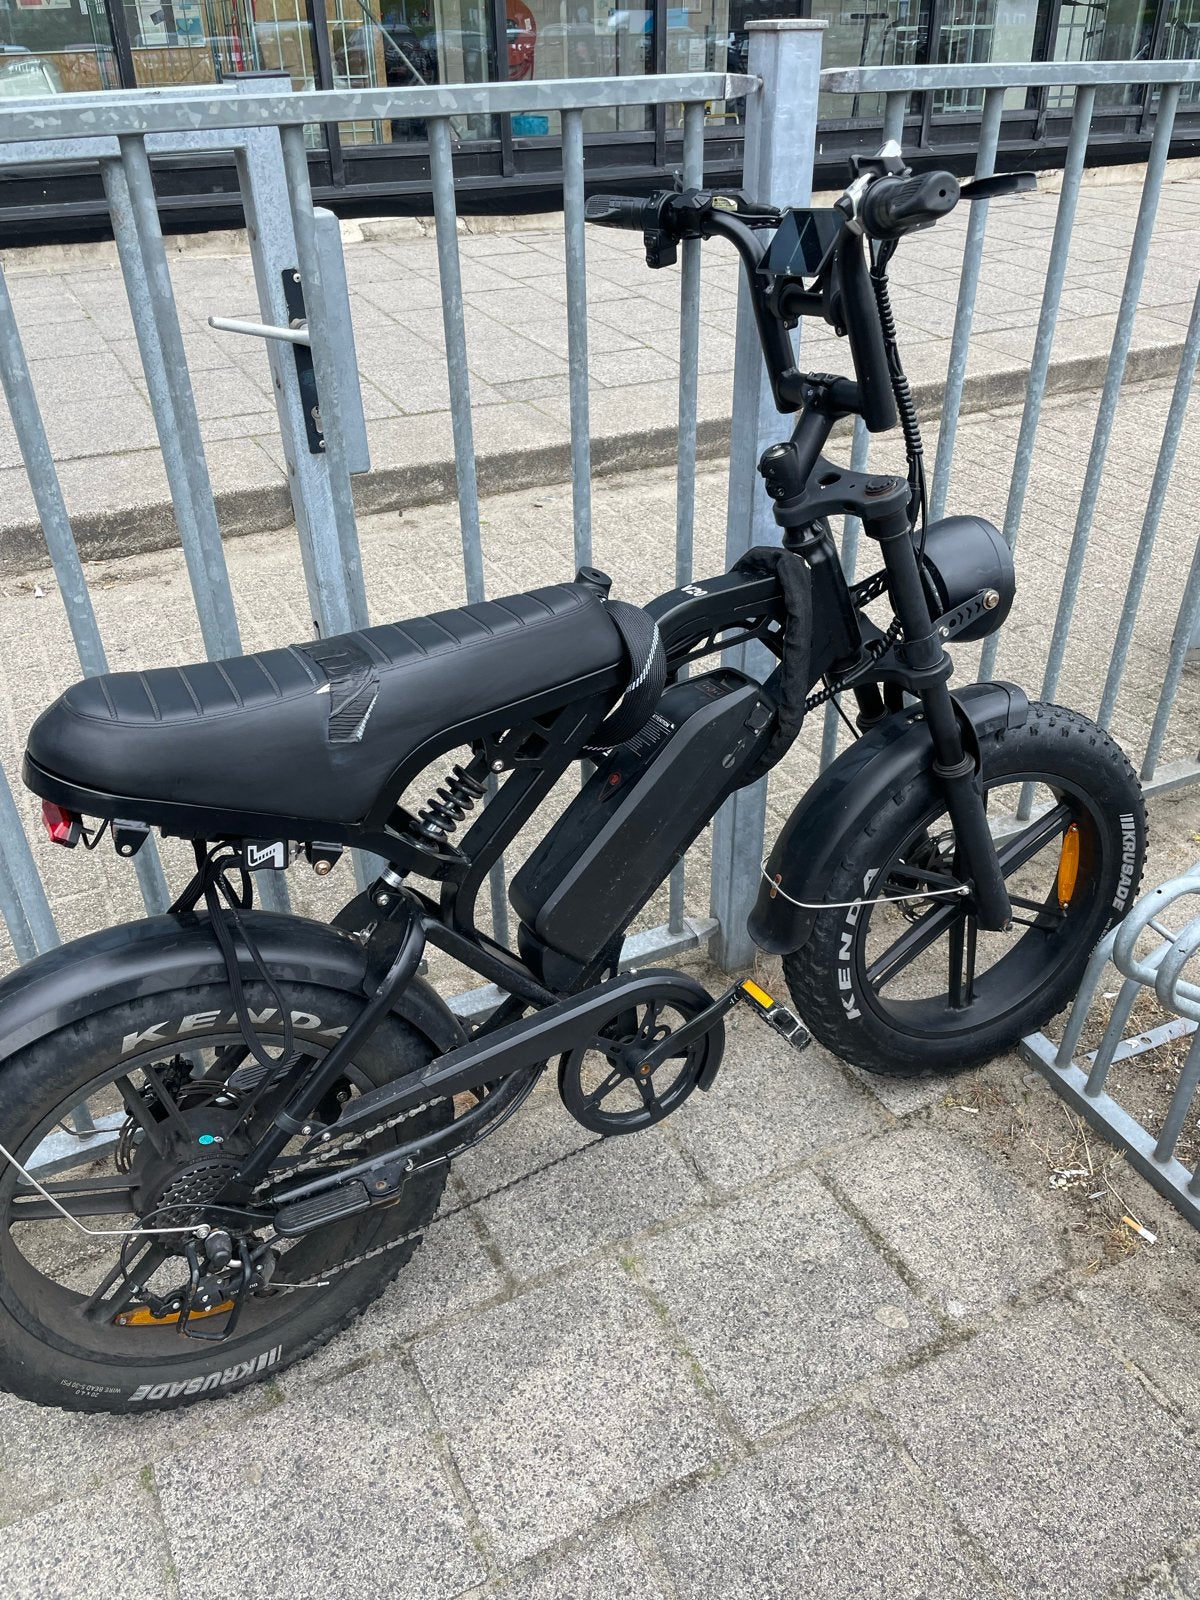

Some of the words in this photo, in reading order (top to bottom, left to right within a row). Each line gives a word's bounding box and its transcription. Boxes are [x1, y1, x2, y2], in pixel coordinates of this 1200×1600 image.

[680, 584, 708, 597] V20
[1112, 830, 1136, 912] KRUSADE
[838, 867, 881, 1020] KENDA
[86, 1384, 104, 1393] BEAD
[104, 1386, 121, 1394] WIRE
[127, 1357, 257, 1402] KRUSADE
